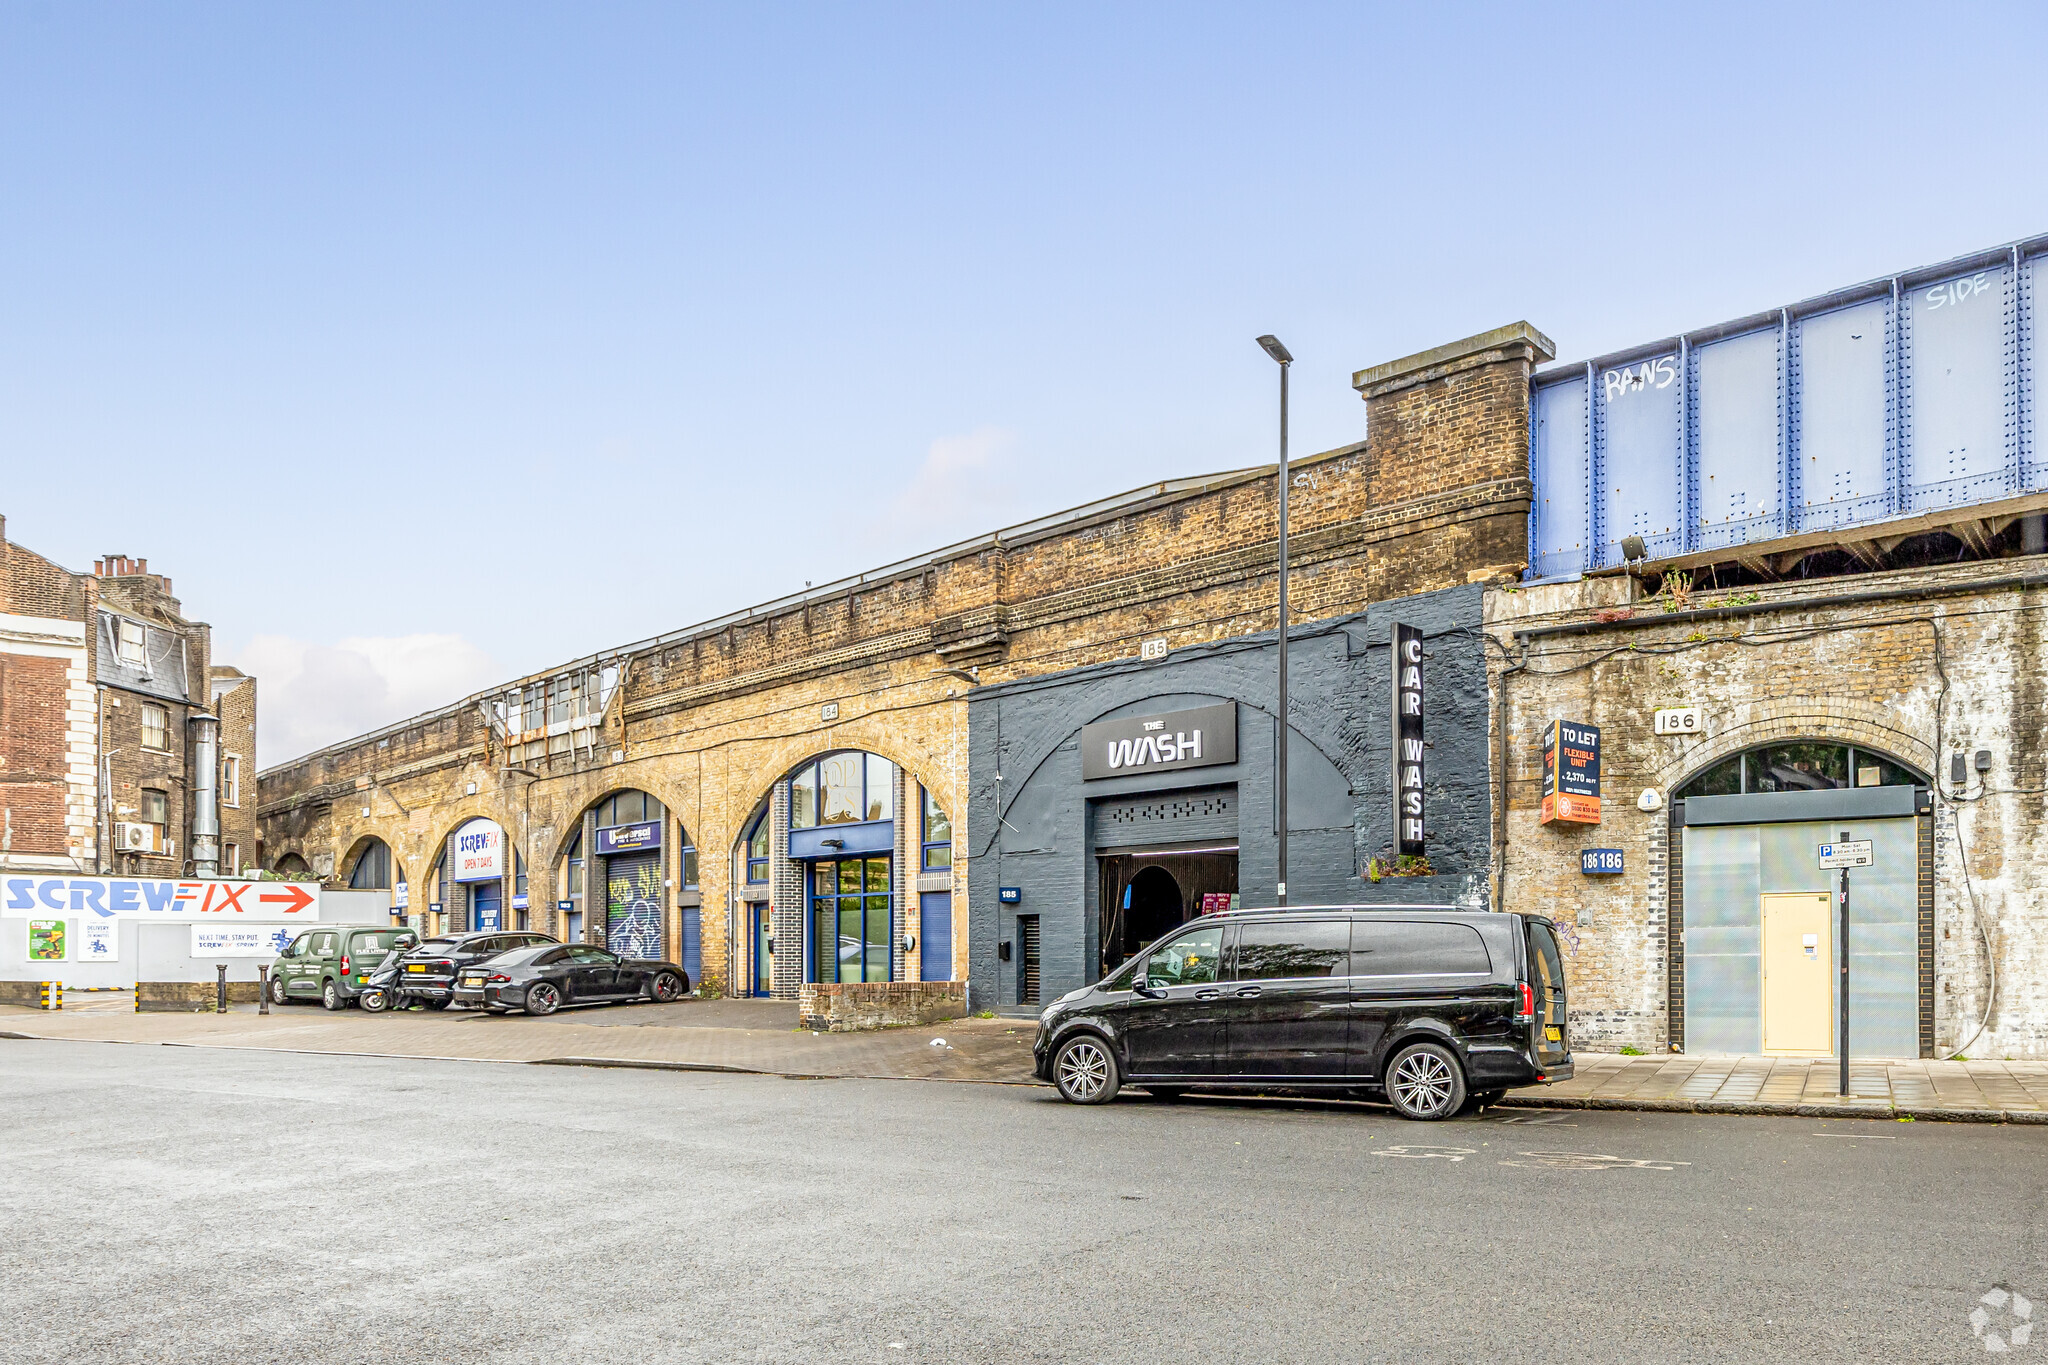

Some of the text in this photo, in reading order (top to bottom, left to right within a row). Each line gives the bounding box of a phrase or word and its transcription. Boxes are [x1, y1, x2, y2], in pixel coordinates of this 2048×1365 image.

[1926, 272, 1991, 310] SIDE
[1604, 355, 1675, 402] RANS
[1143, 641, 1165, 656] 185
[823, 705, 836, 718] 184
[1143, 720, 1165, 731] THE
[1662, 714, 1694, 730] 186
[1402, 639, 1423, 841] CAR WASH
[1562, 728, 1576, 743] TO
[1578, 731, 1597, 746] LET
[1108, 729, 1202, 769] WASH
[1563, 747, 1595, 761] FLEXIBLE
[1570, 757, 1587, 768] UNIT
[1566, 771, 1585, 783] 2,370
[461, 831, 499, 853] SCREWFIX
[1823, 847, 1830, 856] P
[464, 858, 477, 870] OPEN
[480, 856, 493, 868] DAYS
[1582, 852, 1622, 869] 186 186
[7, 879, 252, 918] SCREWFIX
[1002, 890, 1017, 898] 185
